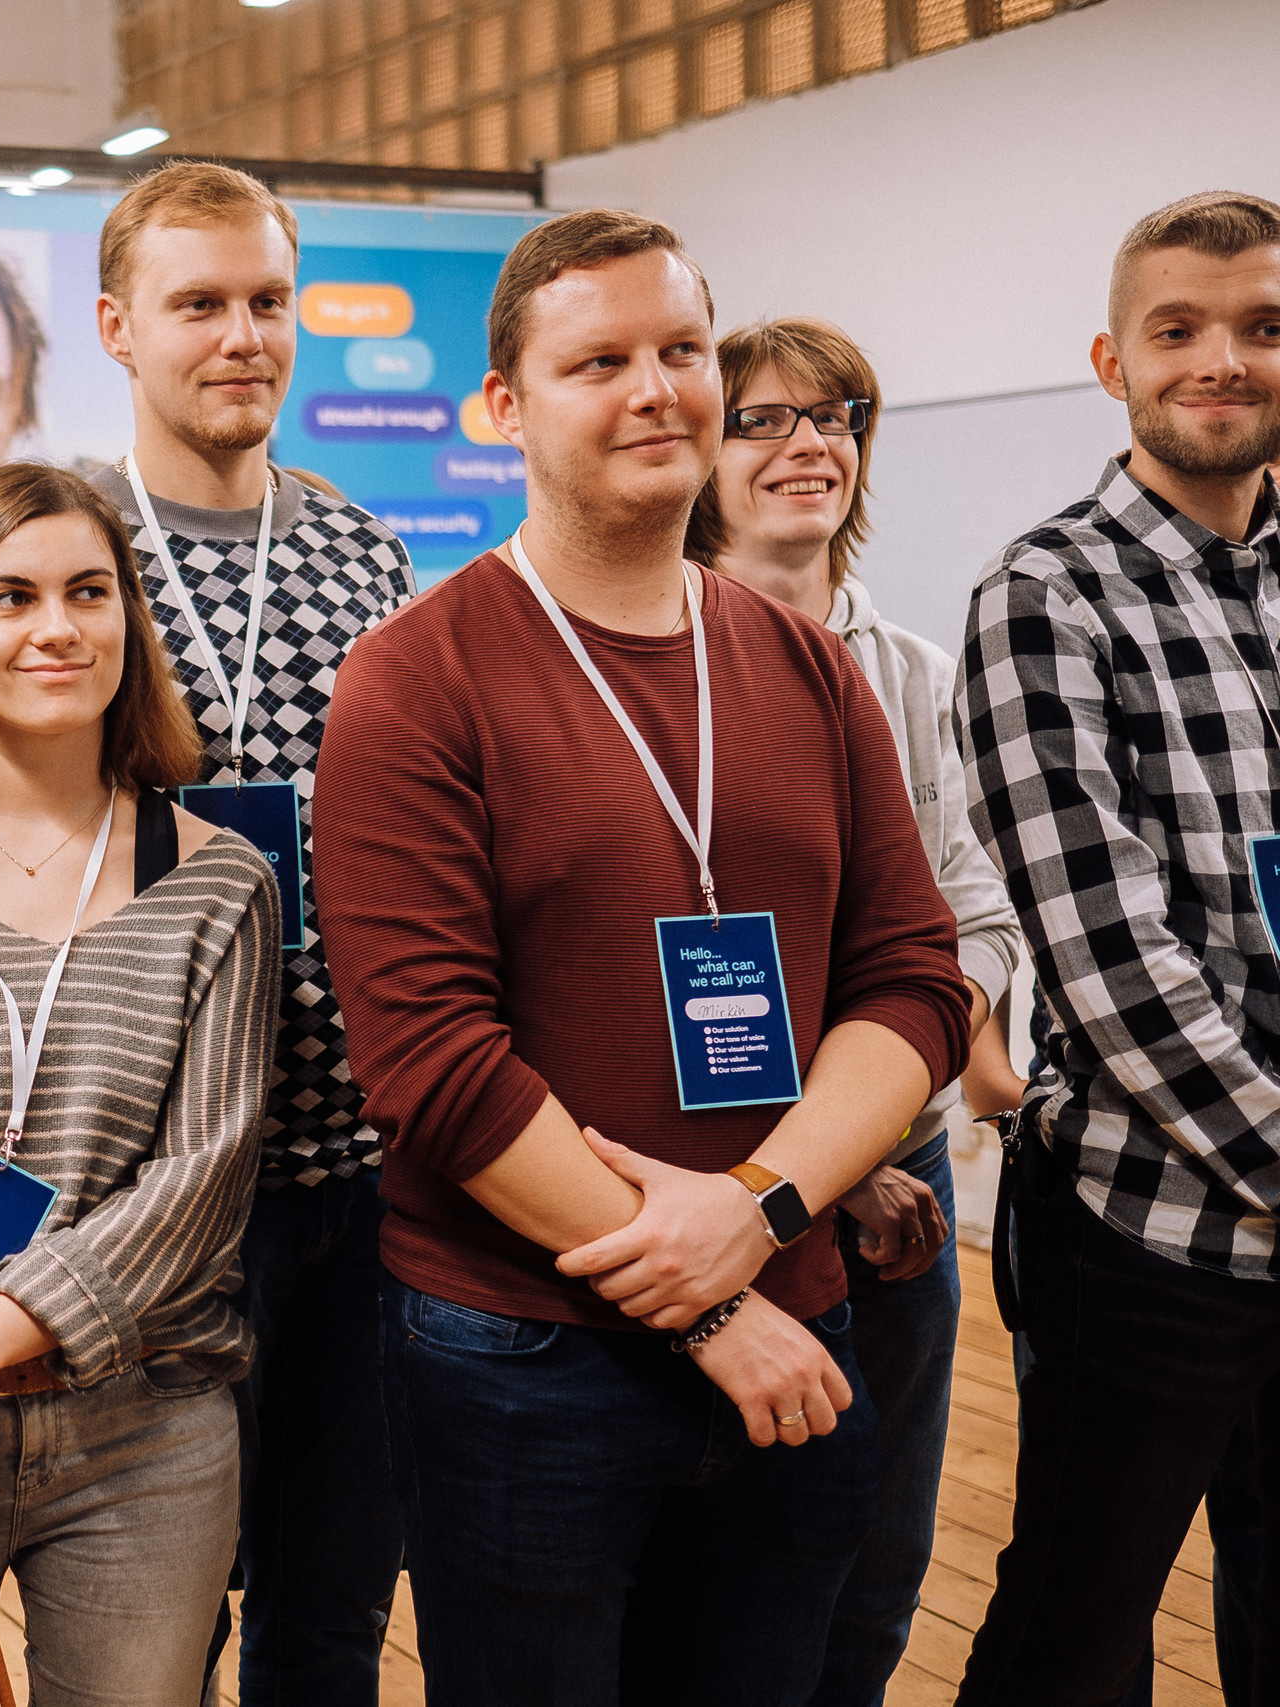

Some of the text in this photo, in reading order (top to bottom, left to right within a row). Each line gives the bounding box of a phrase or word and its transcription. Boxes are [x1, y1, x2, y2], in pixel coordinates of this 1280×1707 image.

[680, 947, 721, 960] Hello...
[697, 961, 755, 973] what can
[689, 971, 765, 987] we call you?
[727, 1045, 745, 1053] visual
[730, 1065, 762, 1073] customers
